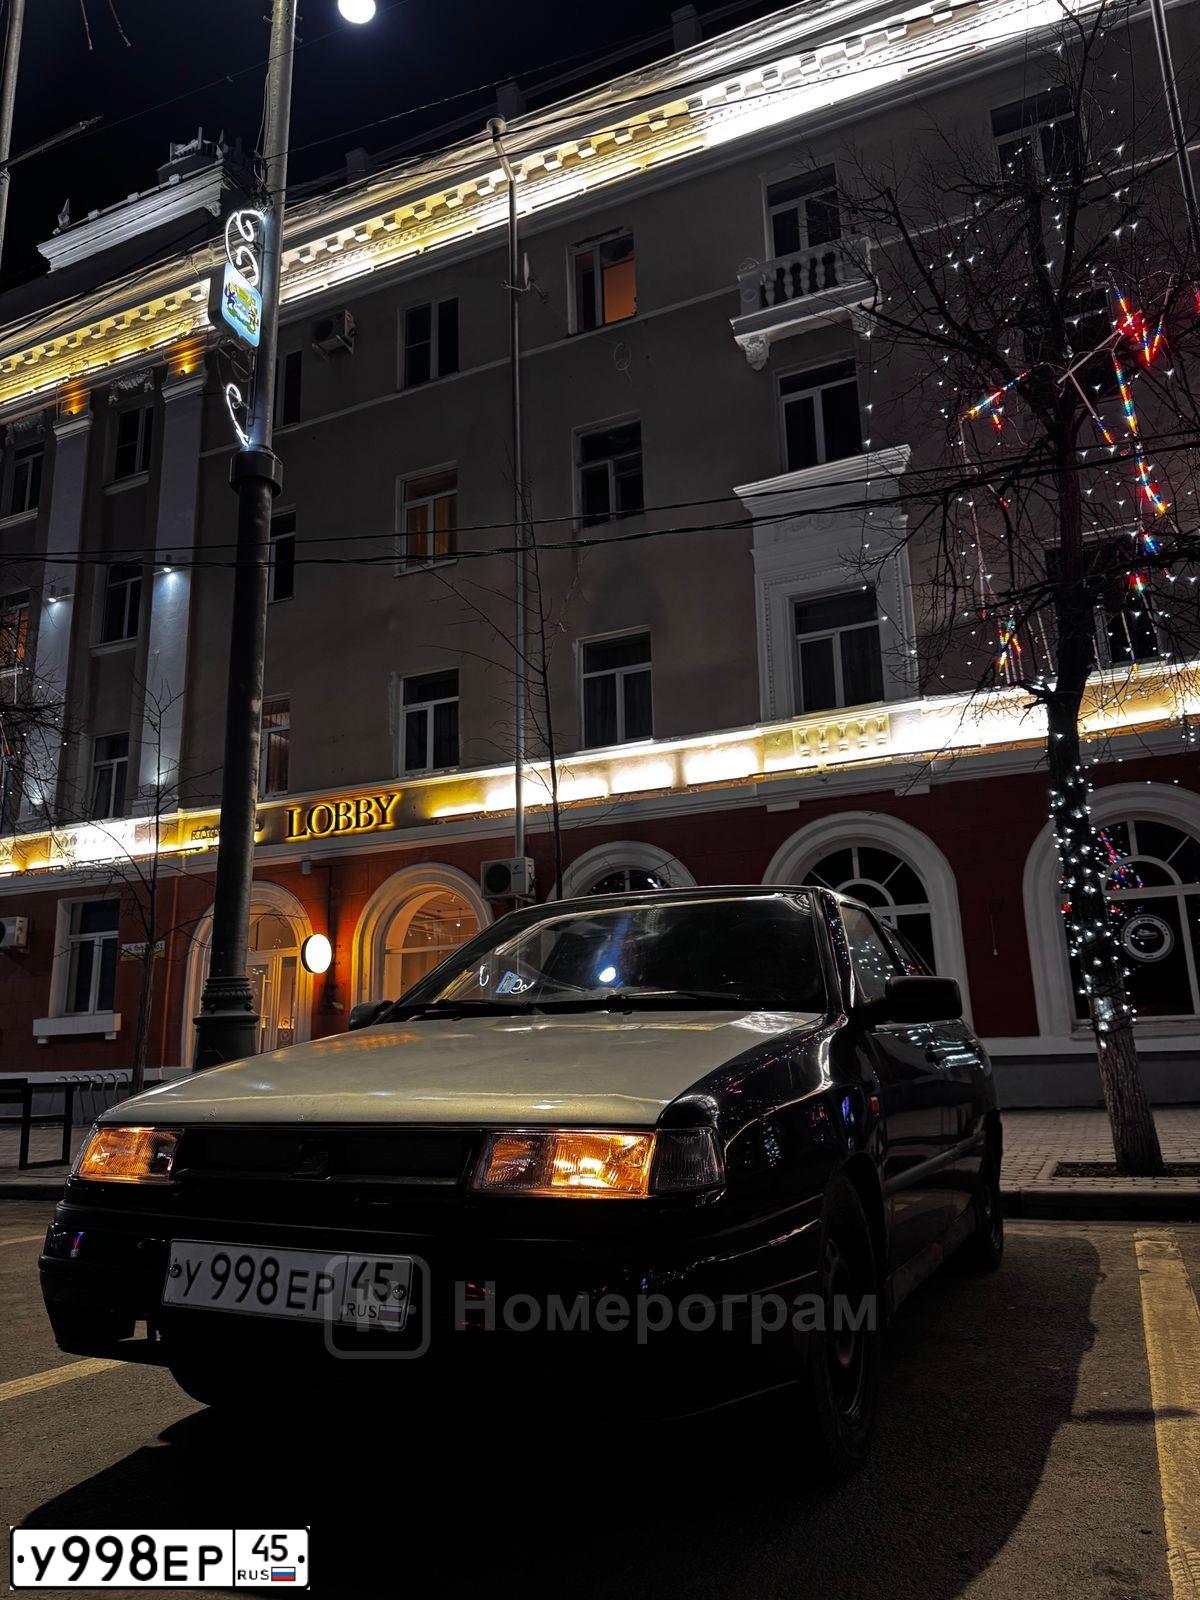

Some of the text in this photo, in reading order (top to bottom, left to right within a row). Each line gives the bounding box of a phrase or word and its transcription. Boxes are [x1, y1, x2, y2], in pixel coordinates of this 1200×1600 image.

[285, 793, 398, 840] LOBBY
[350, 1261, 393, 1302] 45
[346, 1303, 377, 1319] RUS
